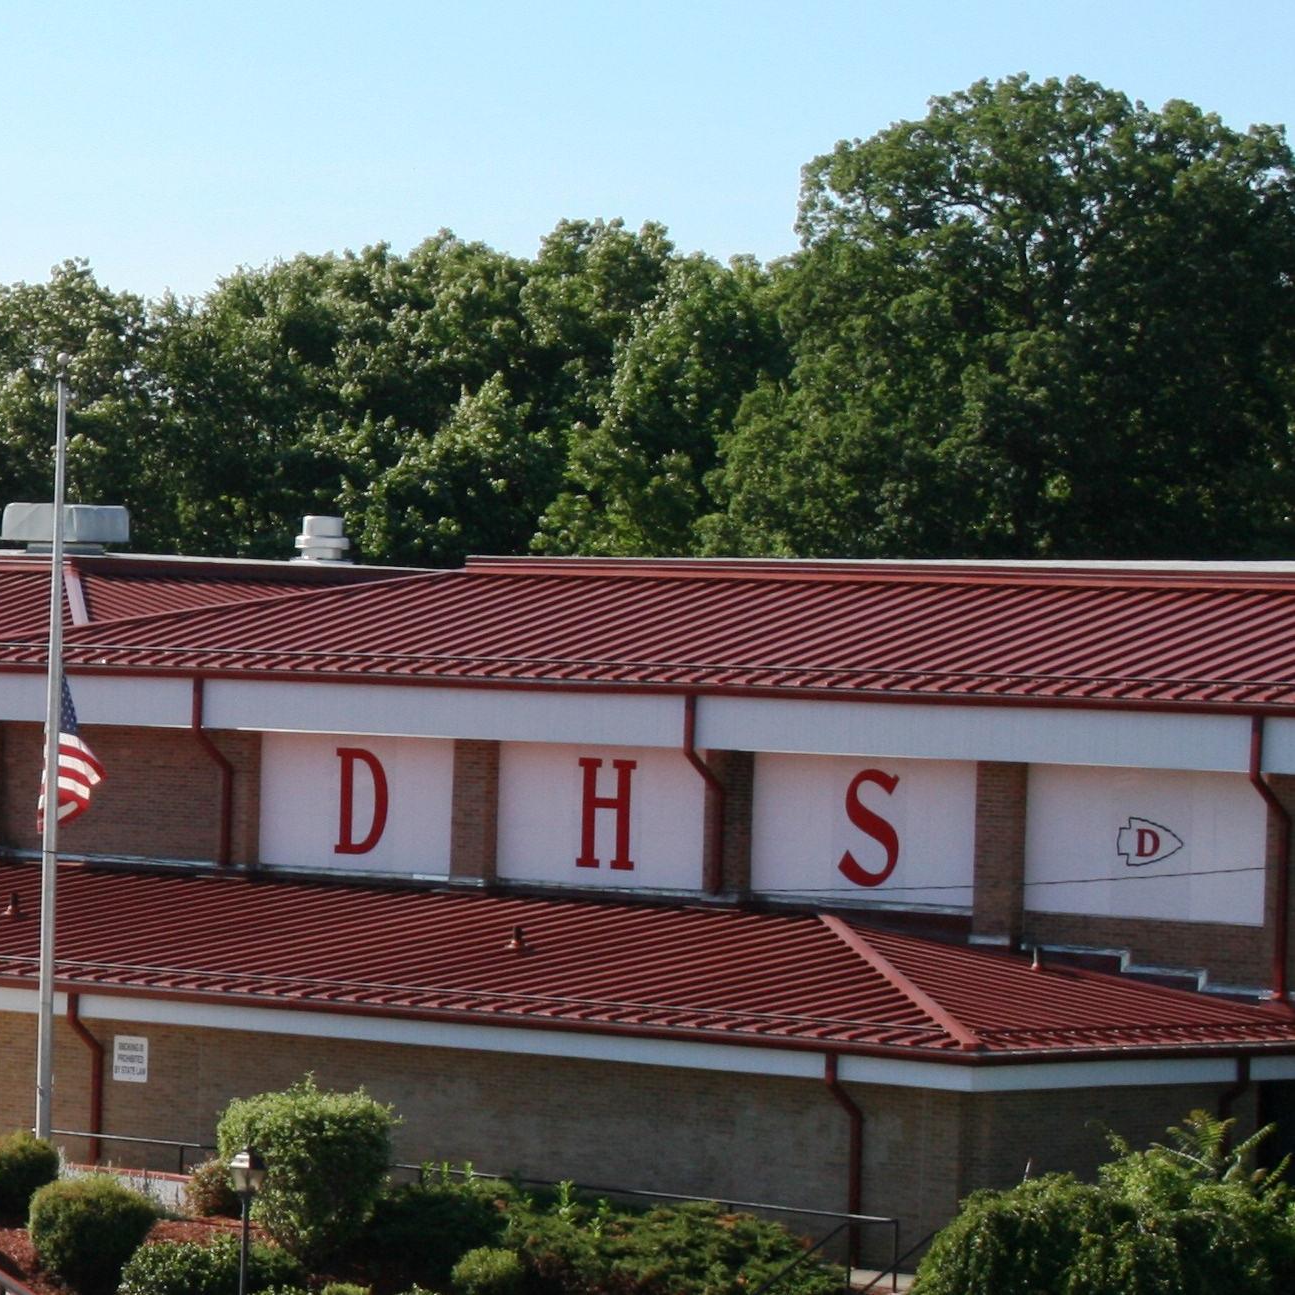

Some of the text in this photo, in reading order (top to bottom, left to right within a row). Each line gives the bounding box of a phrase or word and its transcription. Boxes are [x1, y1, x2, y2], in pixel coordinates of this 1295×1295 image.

[334, 747, 900, 887] D H S
[1135, 828, 1160, 857] D
